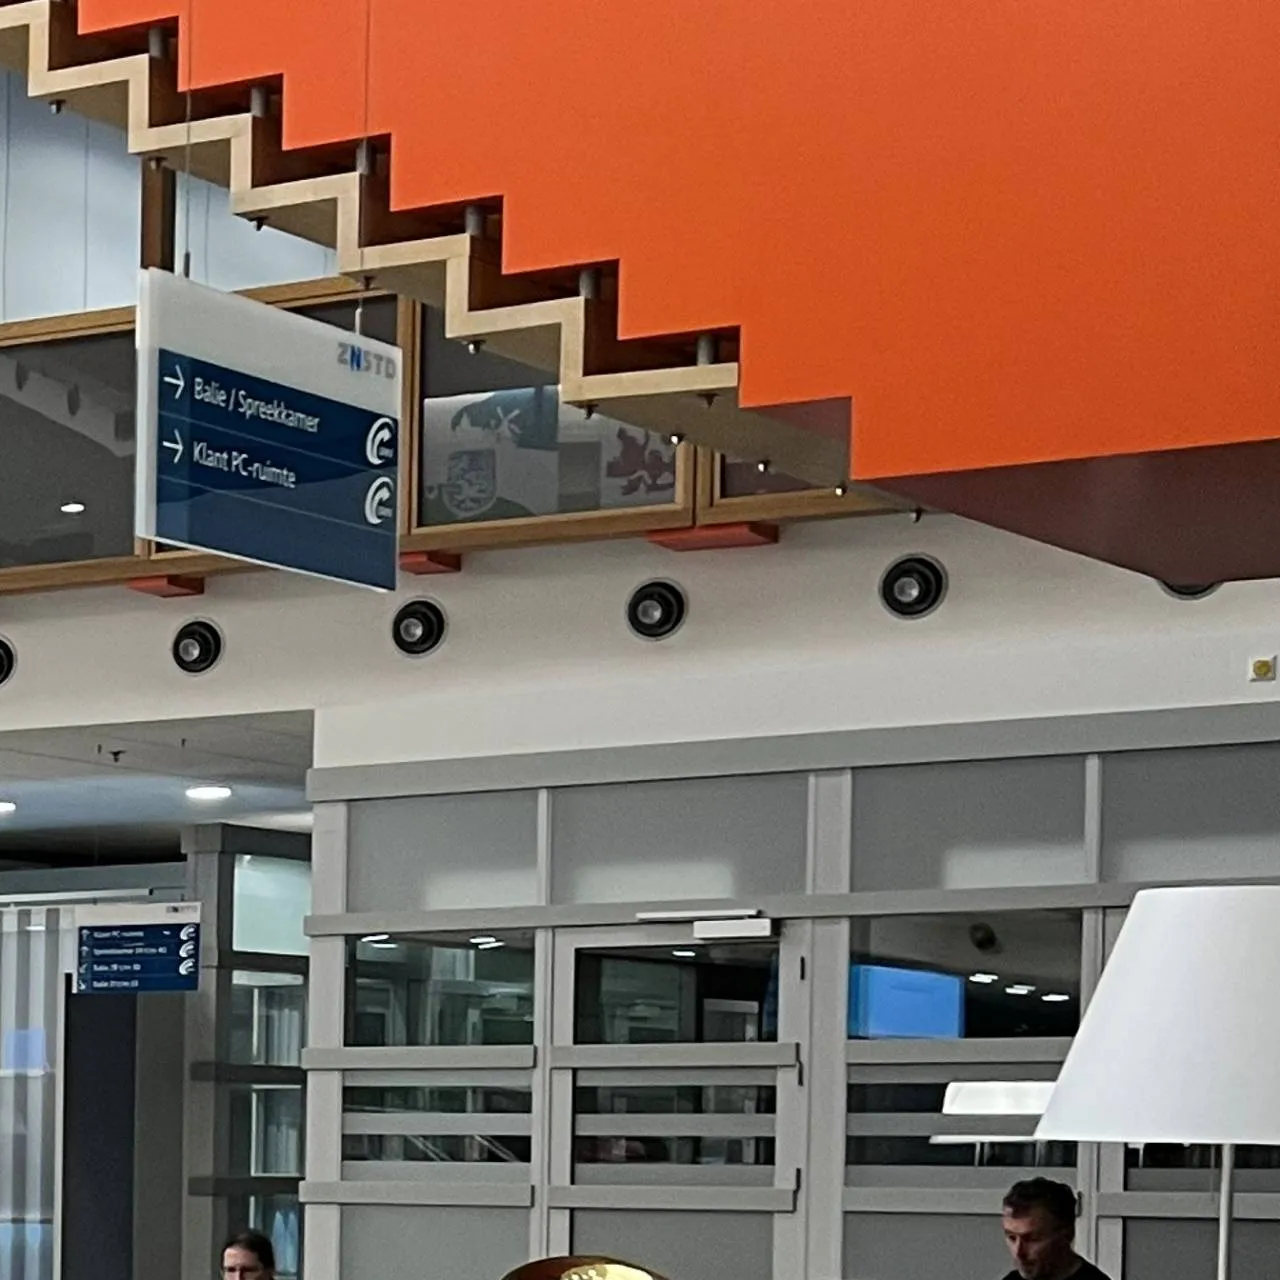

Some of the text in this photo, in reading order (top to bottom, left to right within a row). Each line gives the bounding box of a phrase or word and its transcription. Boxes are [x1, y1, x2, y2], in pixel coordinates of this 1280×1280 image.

[337, 341, 396, 380] ZNSTD
[194, 377, 321, 433] Balie / Spreekkamer
[193, 441, 297, 489] Klant PC-ruimte
